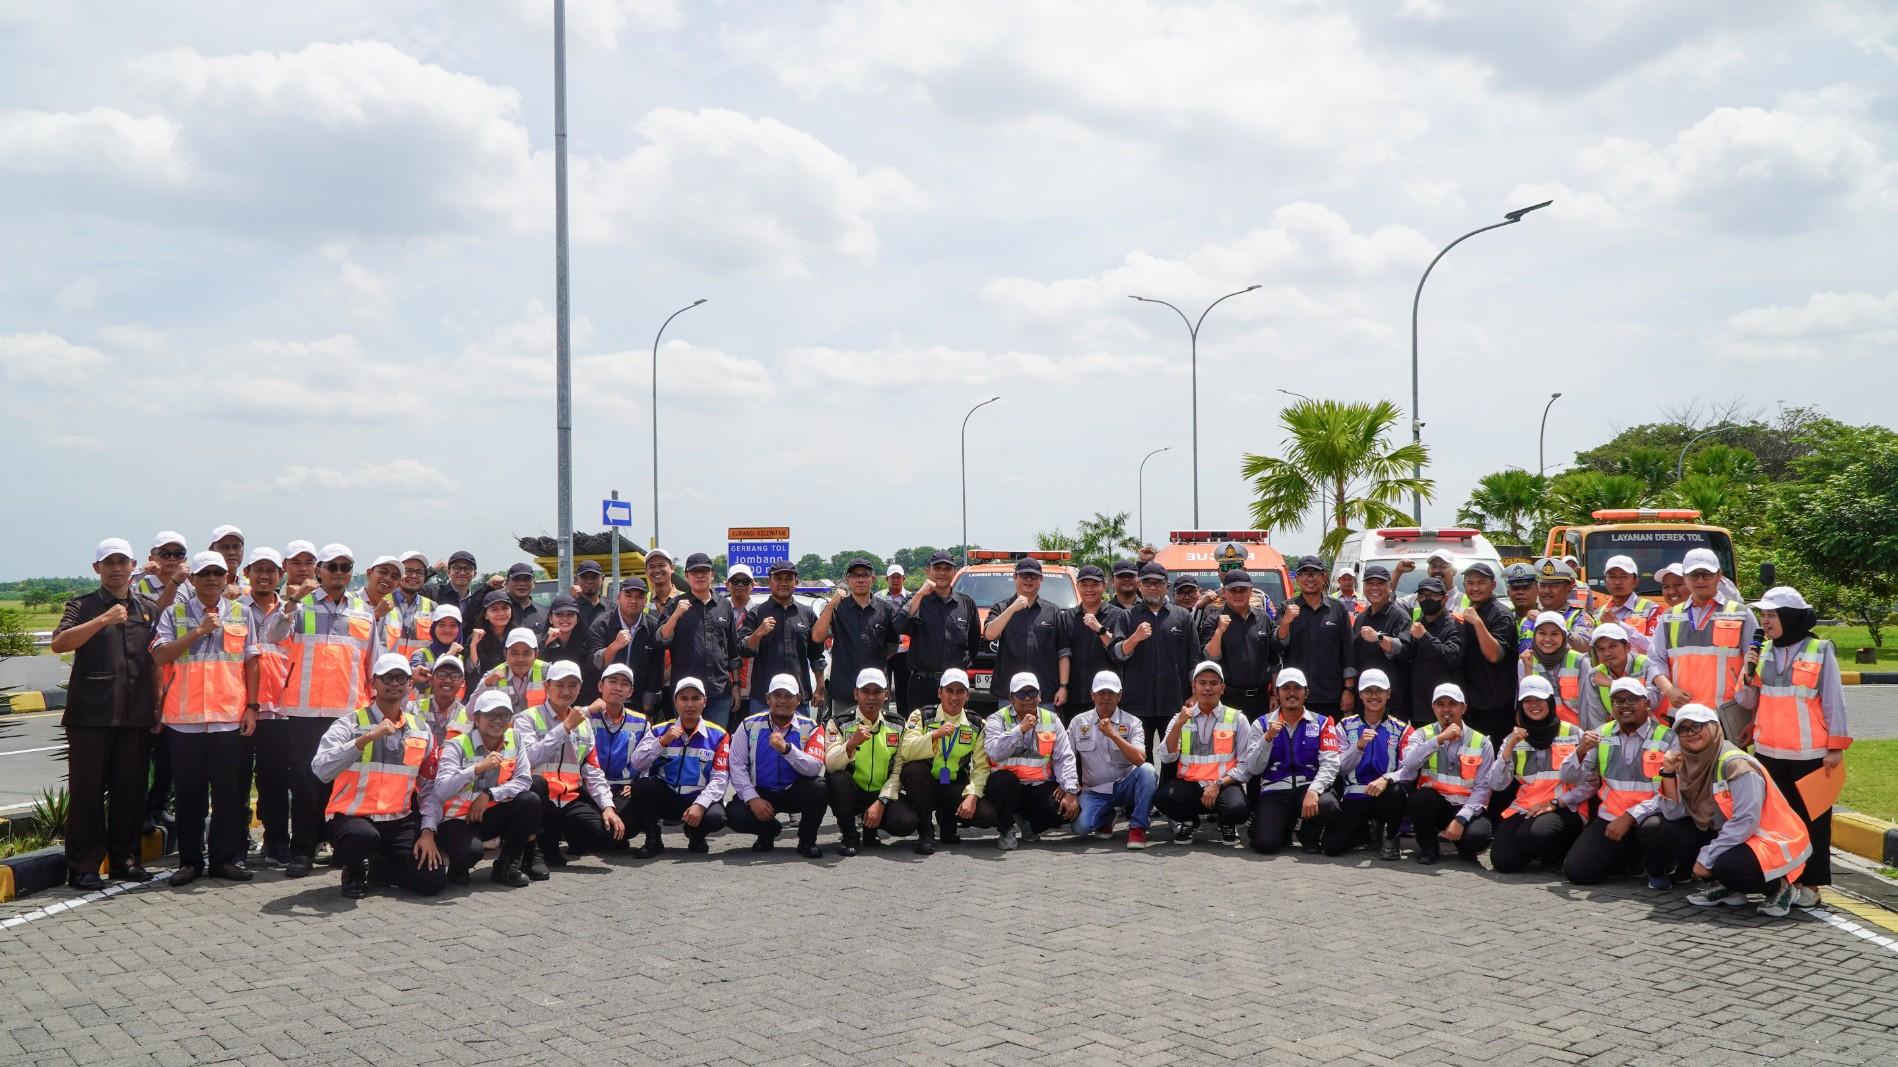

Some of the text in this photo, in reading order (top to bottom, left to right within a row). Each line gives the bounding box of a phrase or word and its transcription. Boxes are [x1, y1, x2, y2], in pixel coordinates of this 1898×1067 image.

[1612, 534, 1704, 542] LAYANAN DEREK TOL
